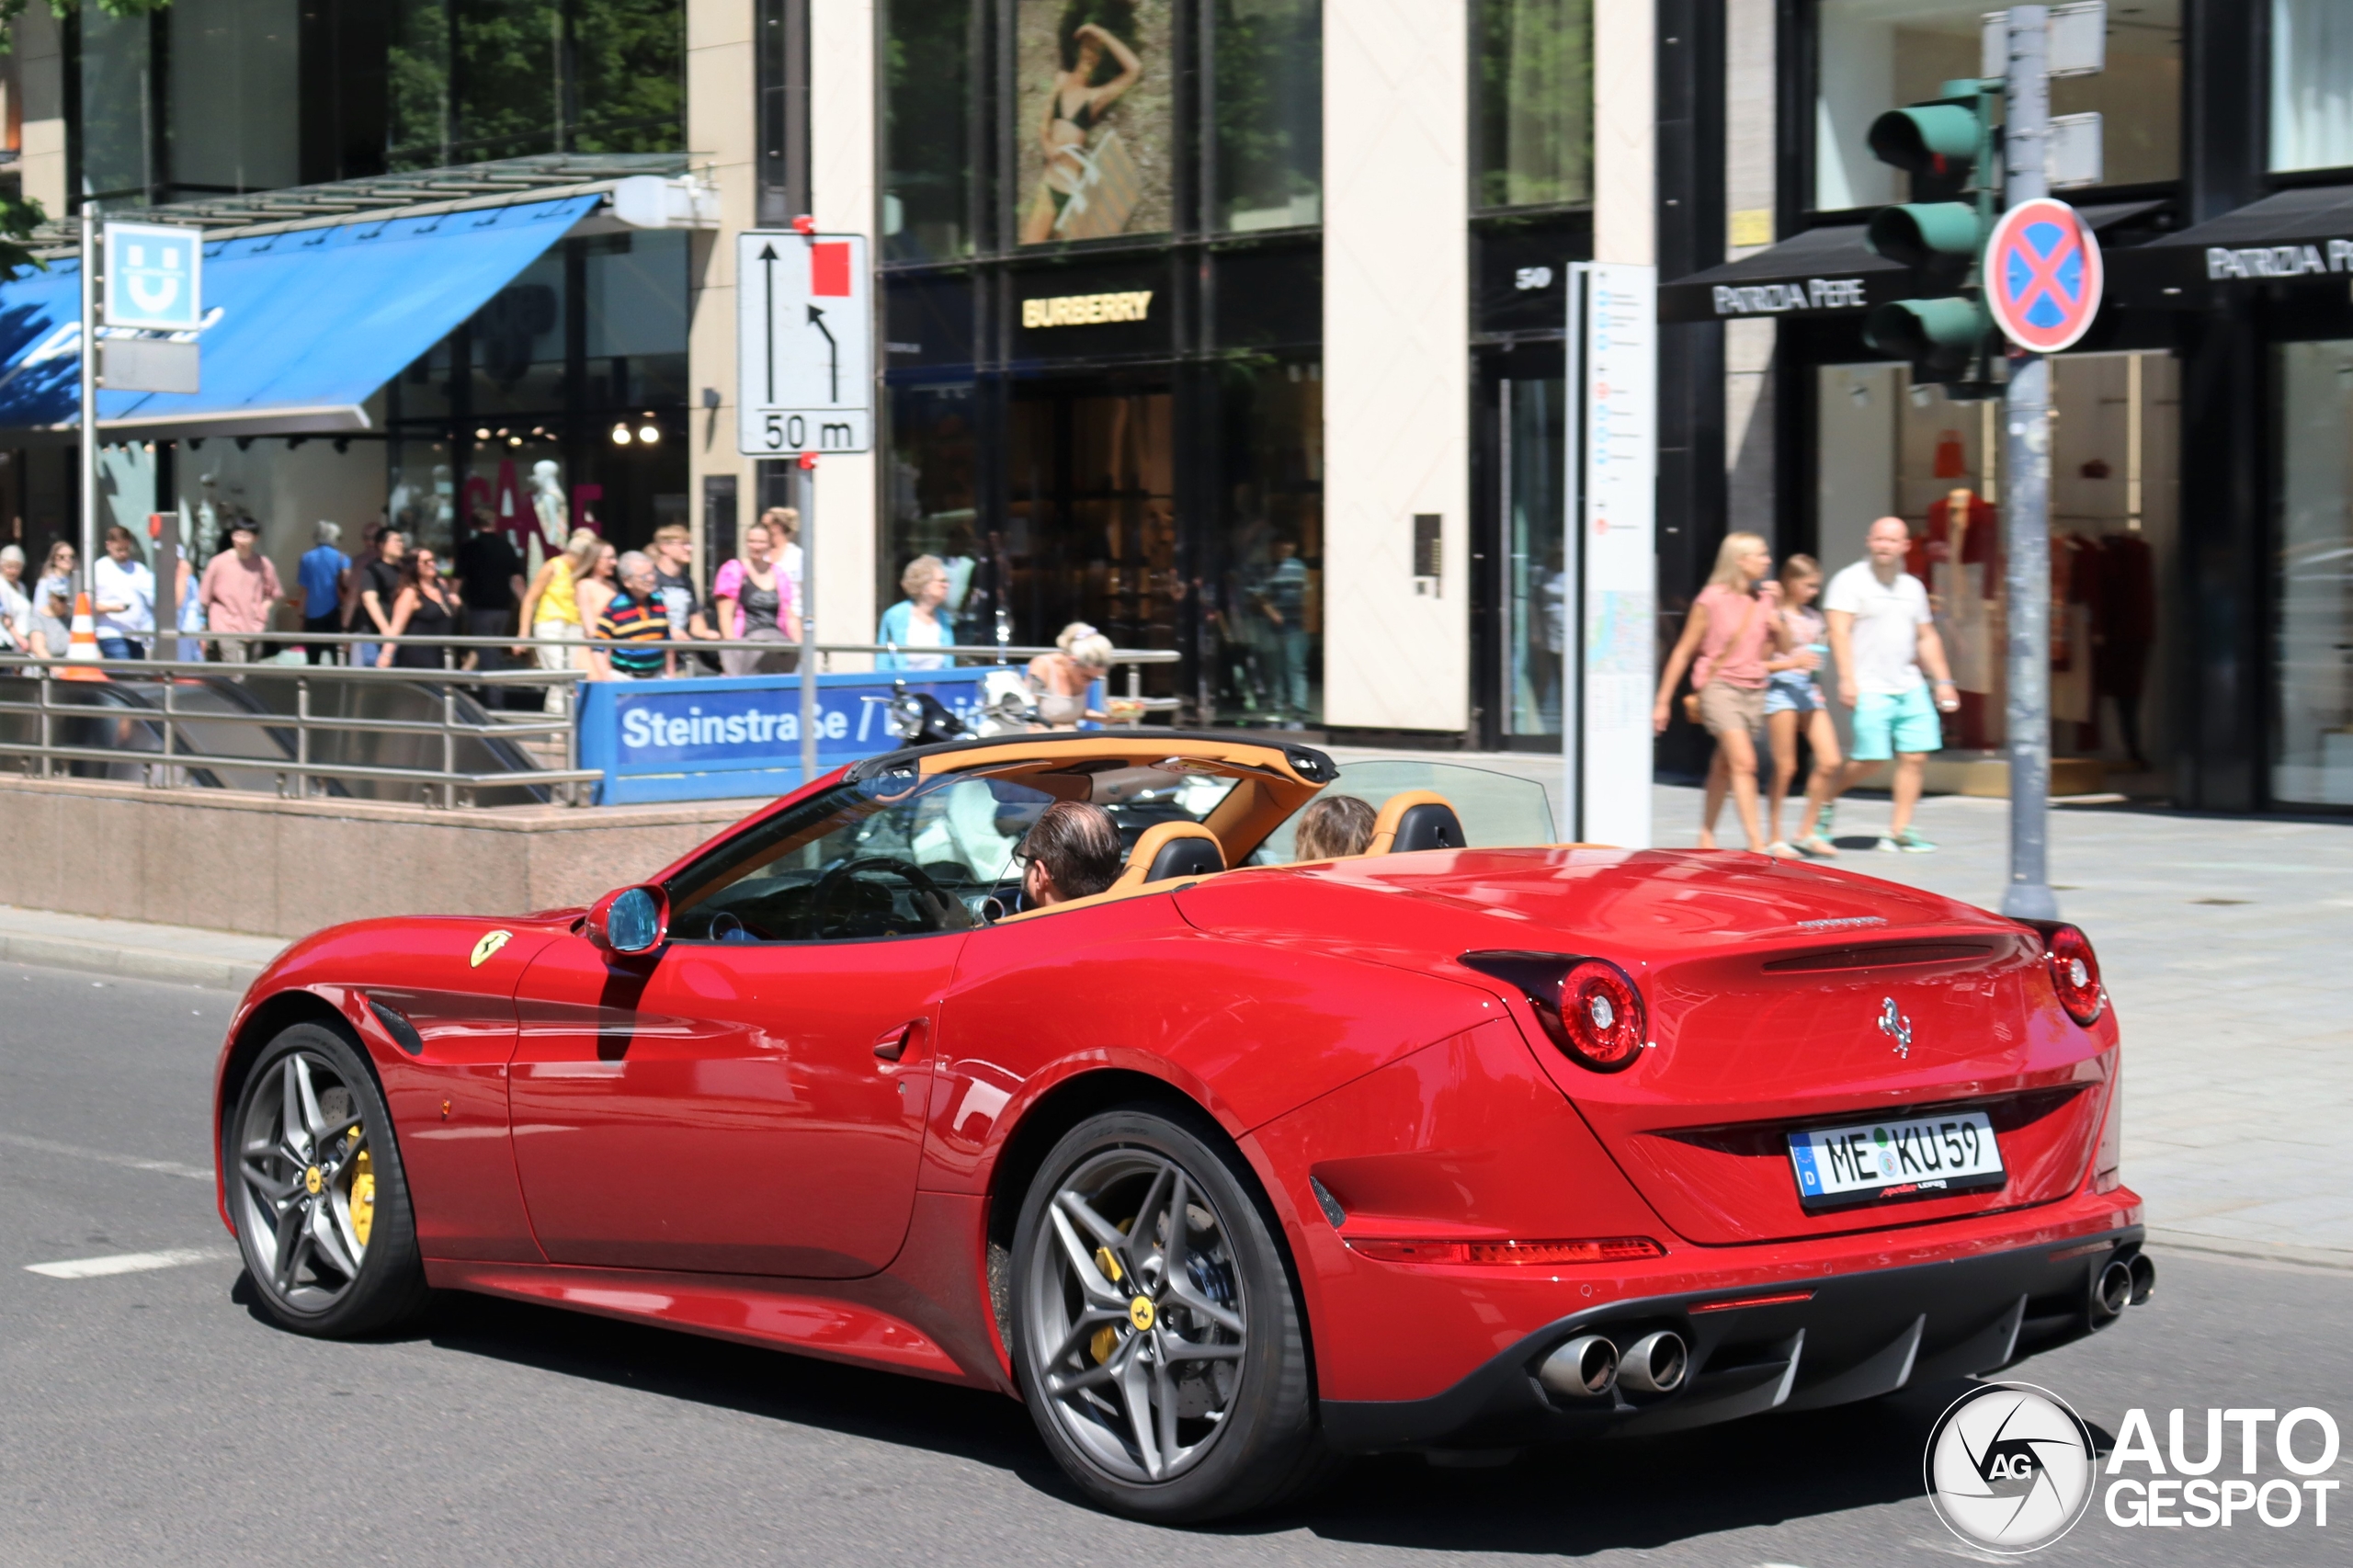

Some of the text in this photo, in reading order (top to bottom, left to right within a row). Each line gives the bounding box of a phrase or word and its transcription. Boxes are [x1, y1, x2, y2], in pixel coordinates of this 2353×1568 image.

[1515, 266, 1553, 290] 50
[1807, 278, 1869, 309] PEPE
[1021, 290, 1154, 328] BURBERRY
[766, 414, 854, 450] 50 m
[1824, 1132, 1879, 1184] ME
[1803, 1170, 1816, 1187] D
